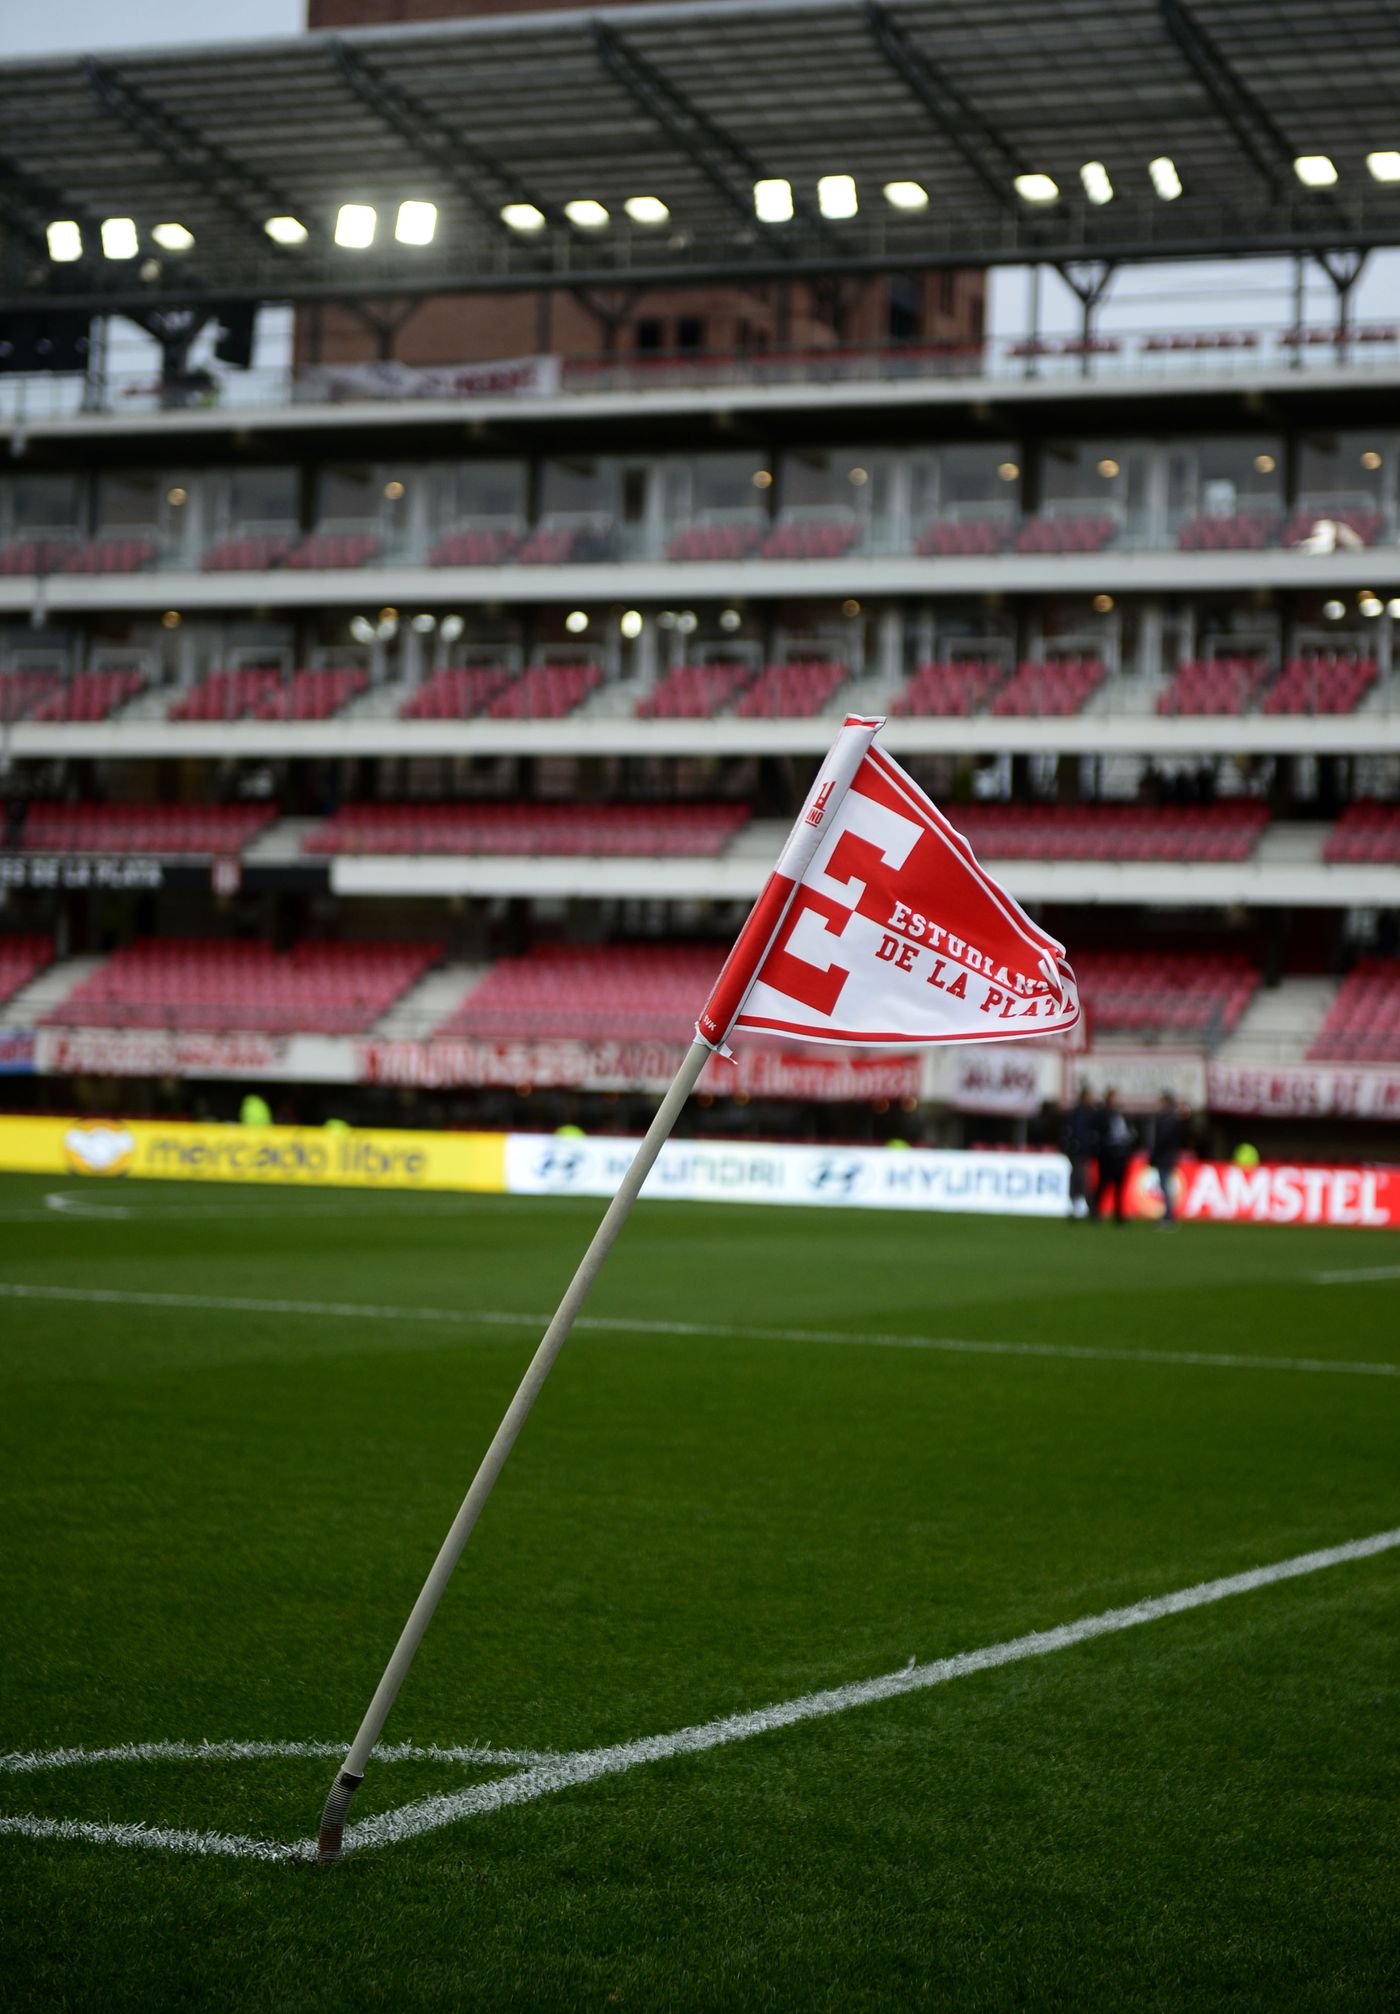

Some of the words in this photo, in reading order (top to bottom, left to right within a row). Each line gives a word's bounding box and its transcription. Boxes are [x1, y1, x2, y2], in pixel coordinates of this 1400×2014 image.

[875, 934, 920, 972] DE
[927, 959, 968, 999] LA
[147, 1135, 328, 1174] mercado
[340, 1137, 428, 1176] libre
[607, 1155, 784, 1188] HUNDAI
[888, 1163, 1062, 1198] HYUNDA
[1185, 1164, 1390, 1226] AMSTEL
